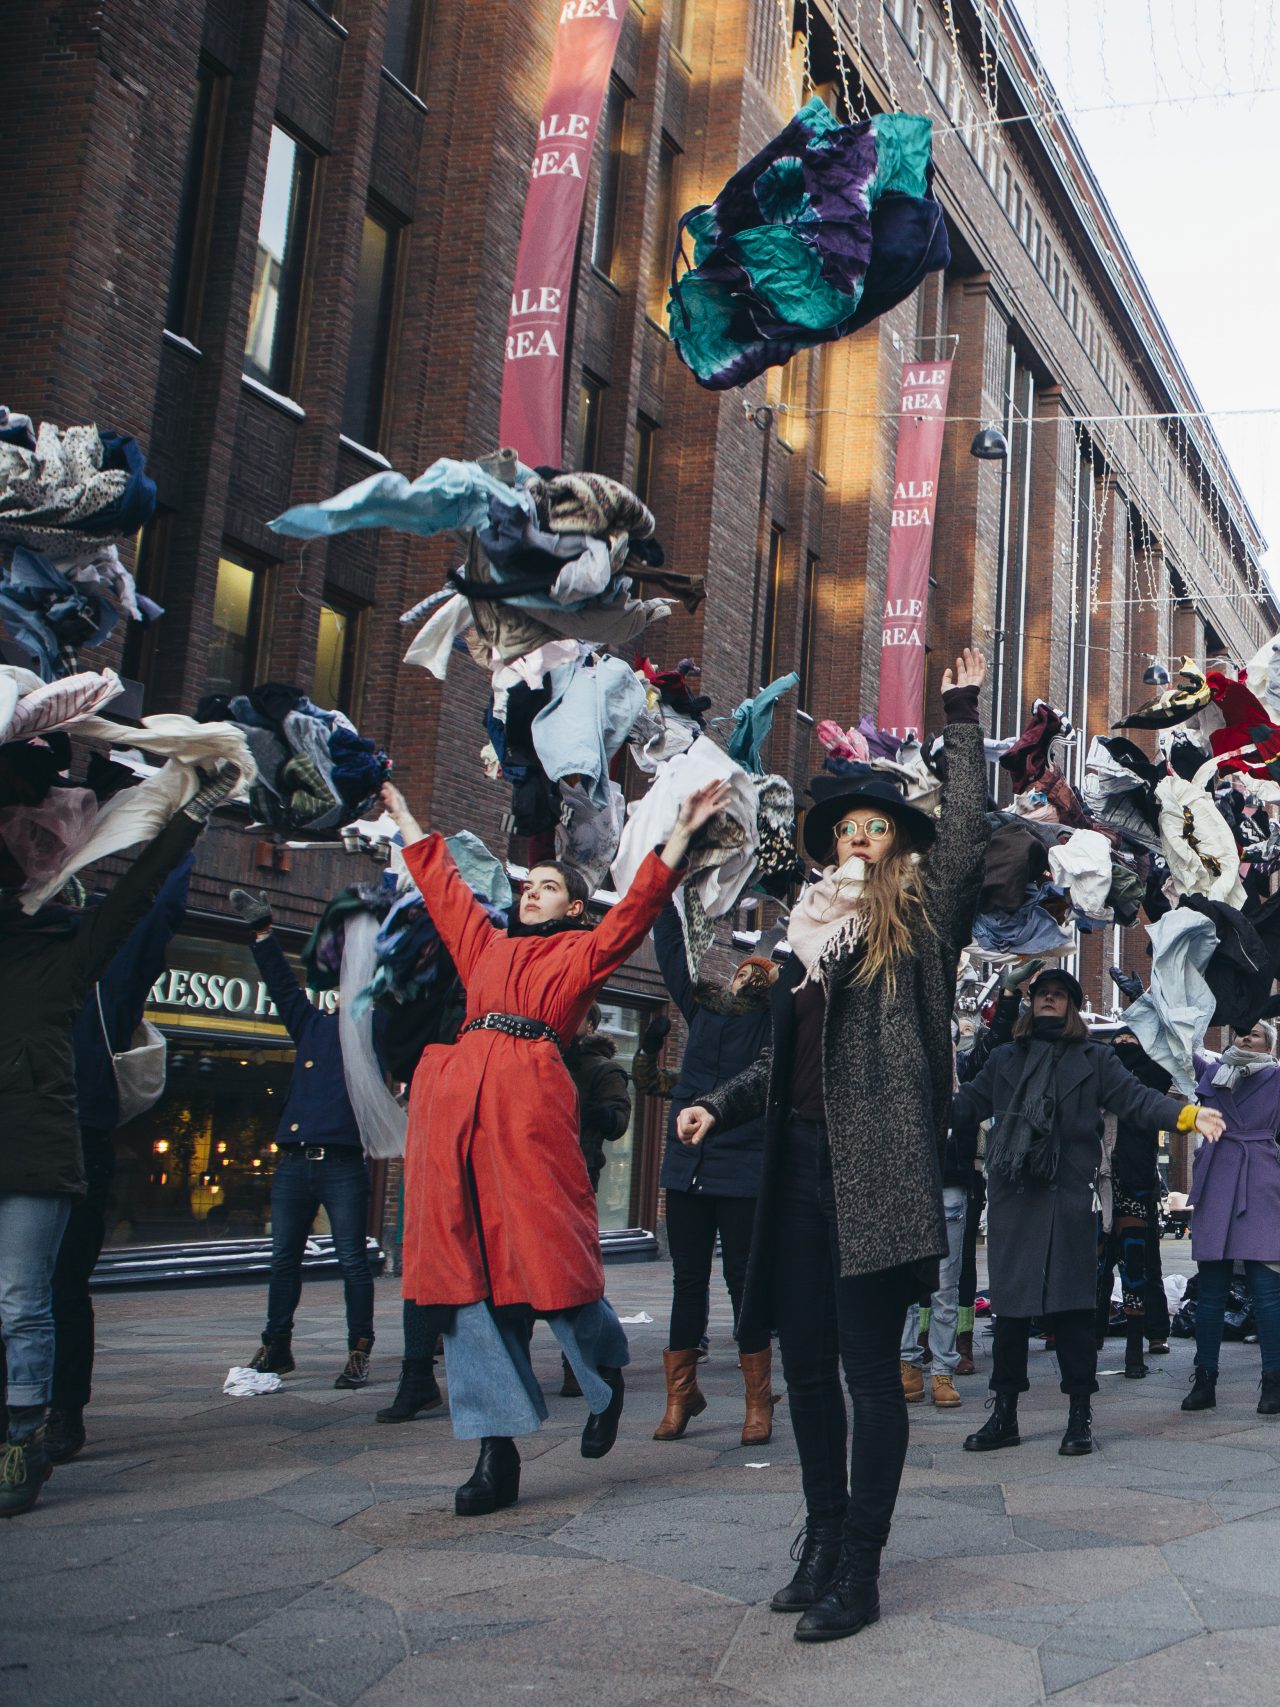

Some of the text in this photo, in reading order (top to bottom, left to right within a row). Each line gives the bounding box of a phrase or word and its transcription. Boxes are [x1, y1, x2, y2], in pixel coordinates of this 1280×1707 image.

[505, 329, 560, 361] REA
[903, 370, 946, 387] ALE
[902, 393, 943, 412] REA
[894, 480, 934, 500] ALE
[891, 506, 931, 527] REA
[882, 599, 922, 619] ALE
[882, 627, 922, 647] REA
[881, 727, 918, 742] LE
